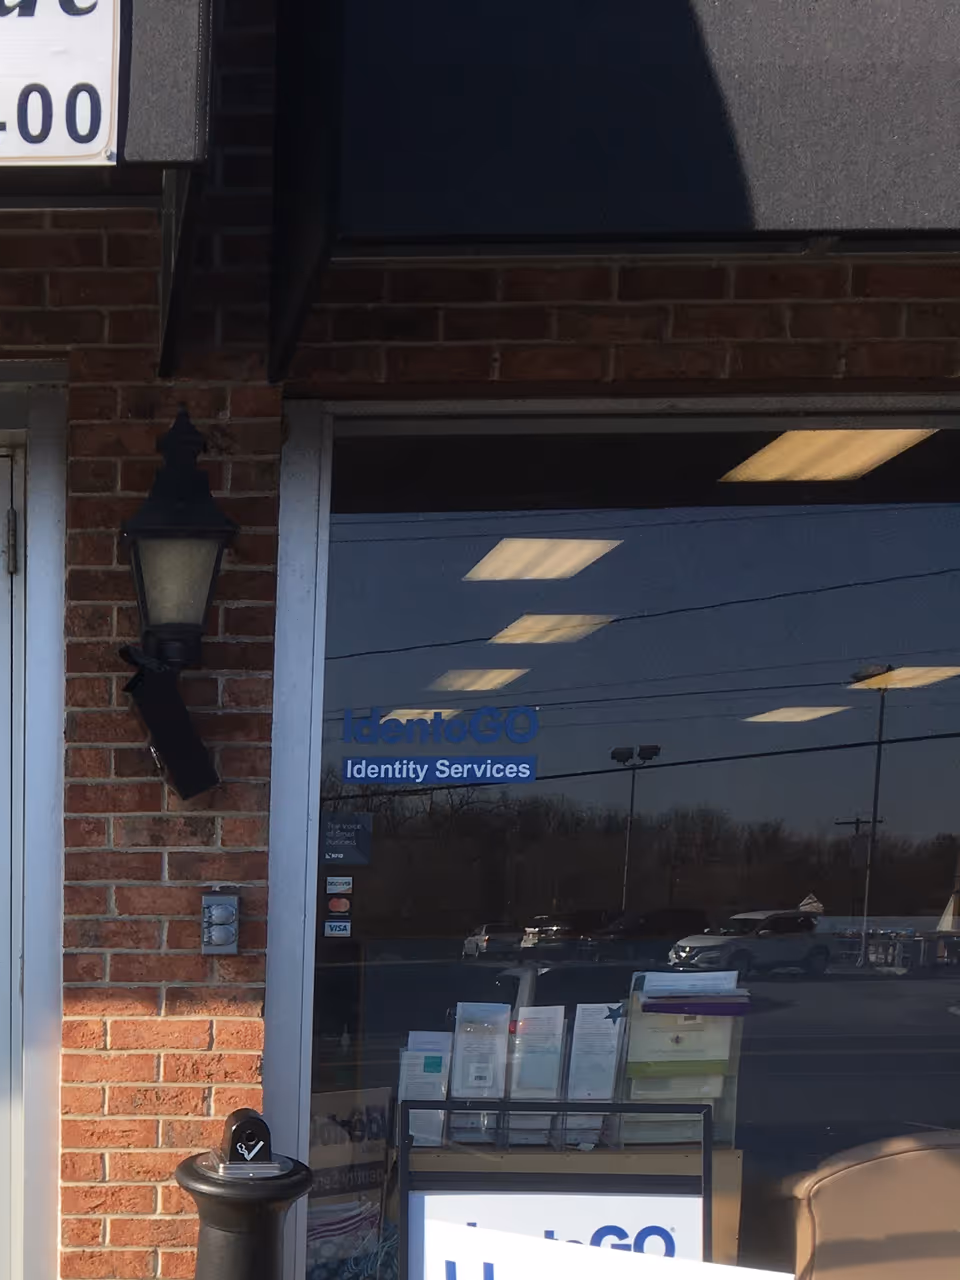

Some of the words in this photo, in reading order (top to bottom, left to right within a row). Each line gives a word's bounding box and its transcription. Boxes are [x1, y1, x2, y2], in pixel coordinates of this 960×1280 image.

[343, 706, 538, 744] IdentoGO
[346, 759, 429, 783] Identity
[435, 759, 531, 779] Services
[329, 924, 349, 933] VISA
